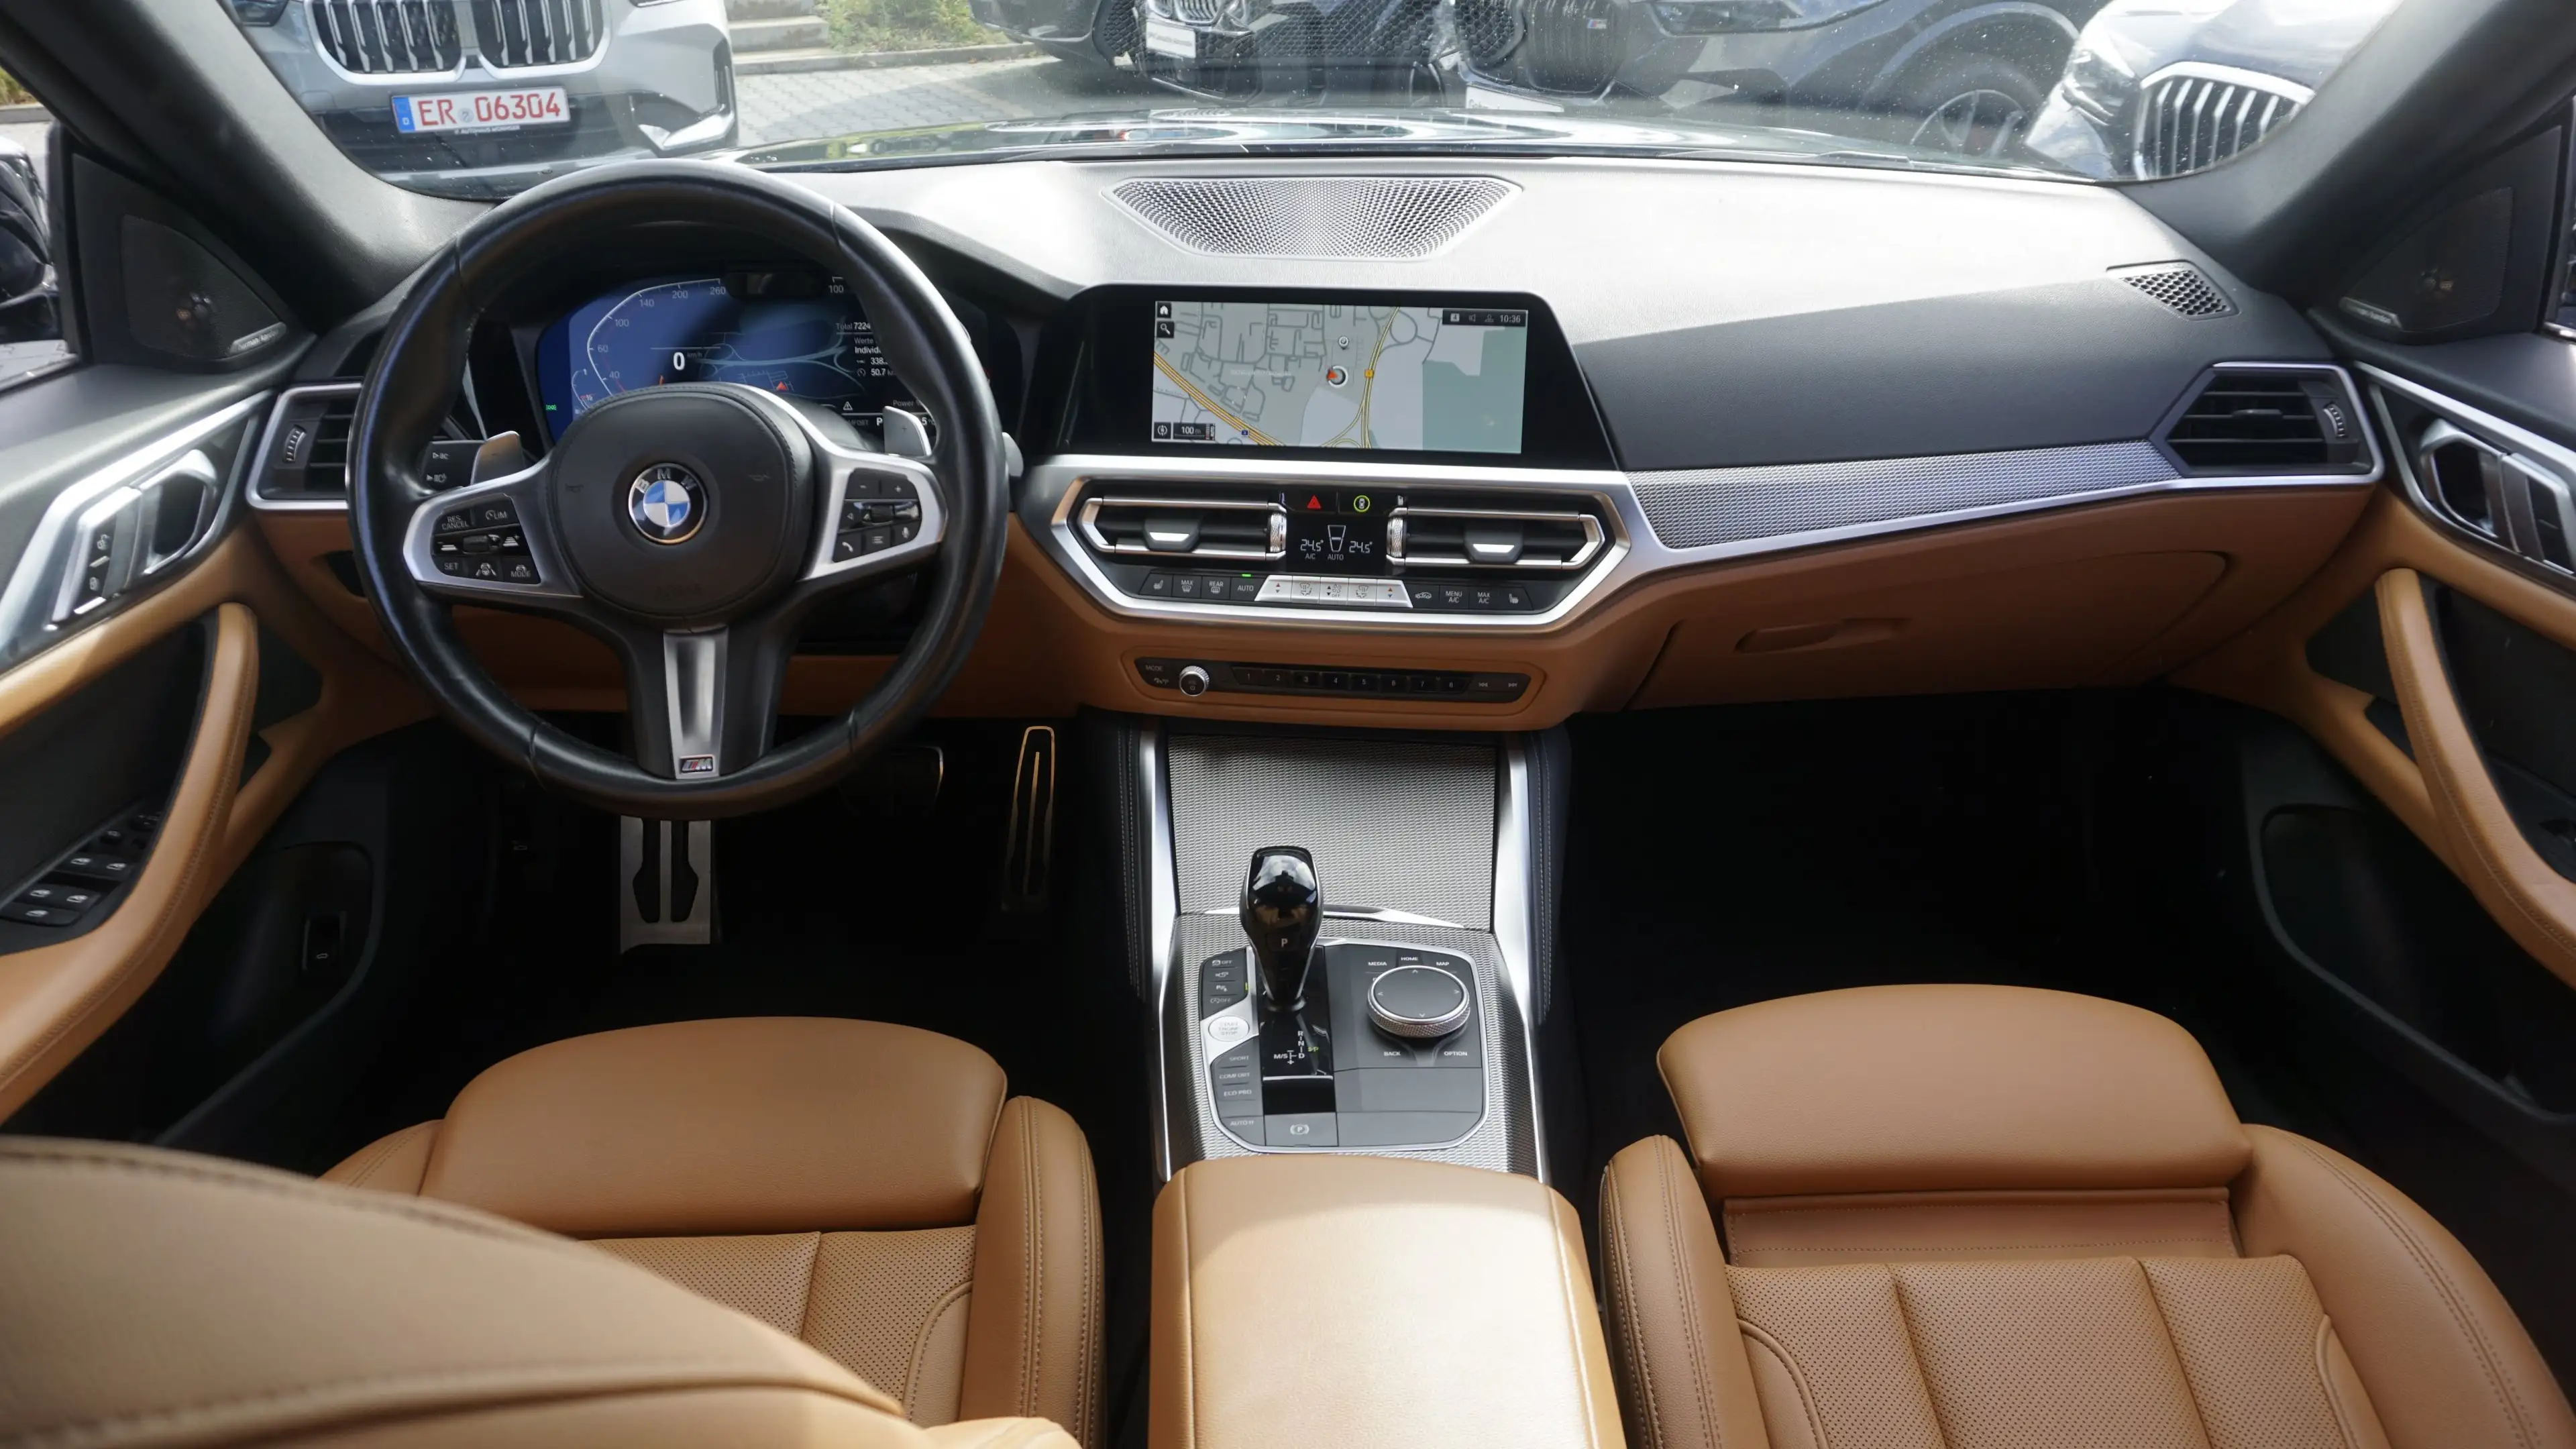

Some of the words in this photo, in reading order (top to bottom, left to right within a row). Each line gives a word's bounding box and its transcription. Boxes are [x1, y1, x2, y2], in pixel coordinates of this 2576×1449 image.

[418, 99, 457, 126] ER
[474, 92, 561, 122] 06304
[710, 286, 726, 295] 260
[829, 284, 844, 294] 100
[672, 290, 688, 299] 200
[639, 299, 655, 308] 140
[614, 319, 629, 327] 100
[1500, 314, 1521, 323] 10:36
[598, 345, 608, 353] 60
[673, 352, 686, 371] 0
[609, 371, 620, 379] 40
[1181, 426, 1195, 435] 100
[636, 468, 697, 493] BMW
[441, 520, 469, 531] CANCEL
[444, 562, 458, 570] SET
[1281, 938, 1289, 948] P
